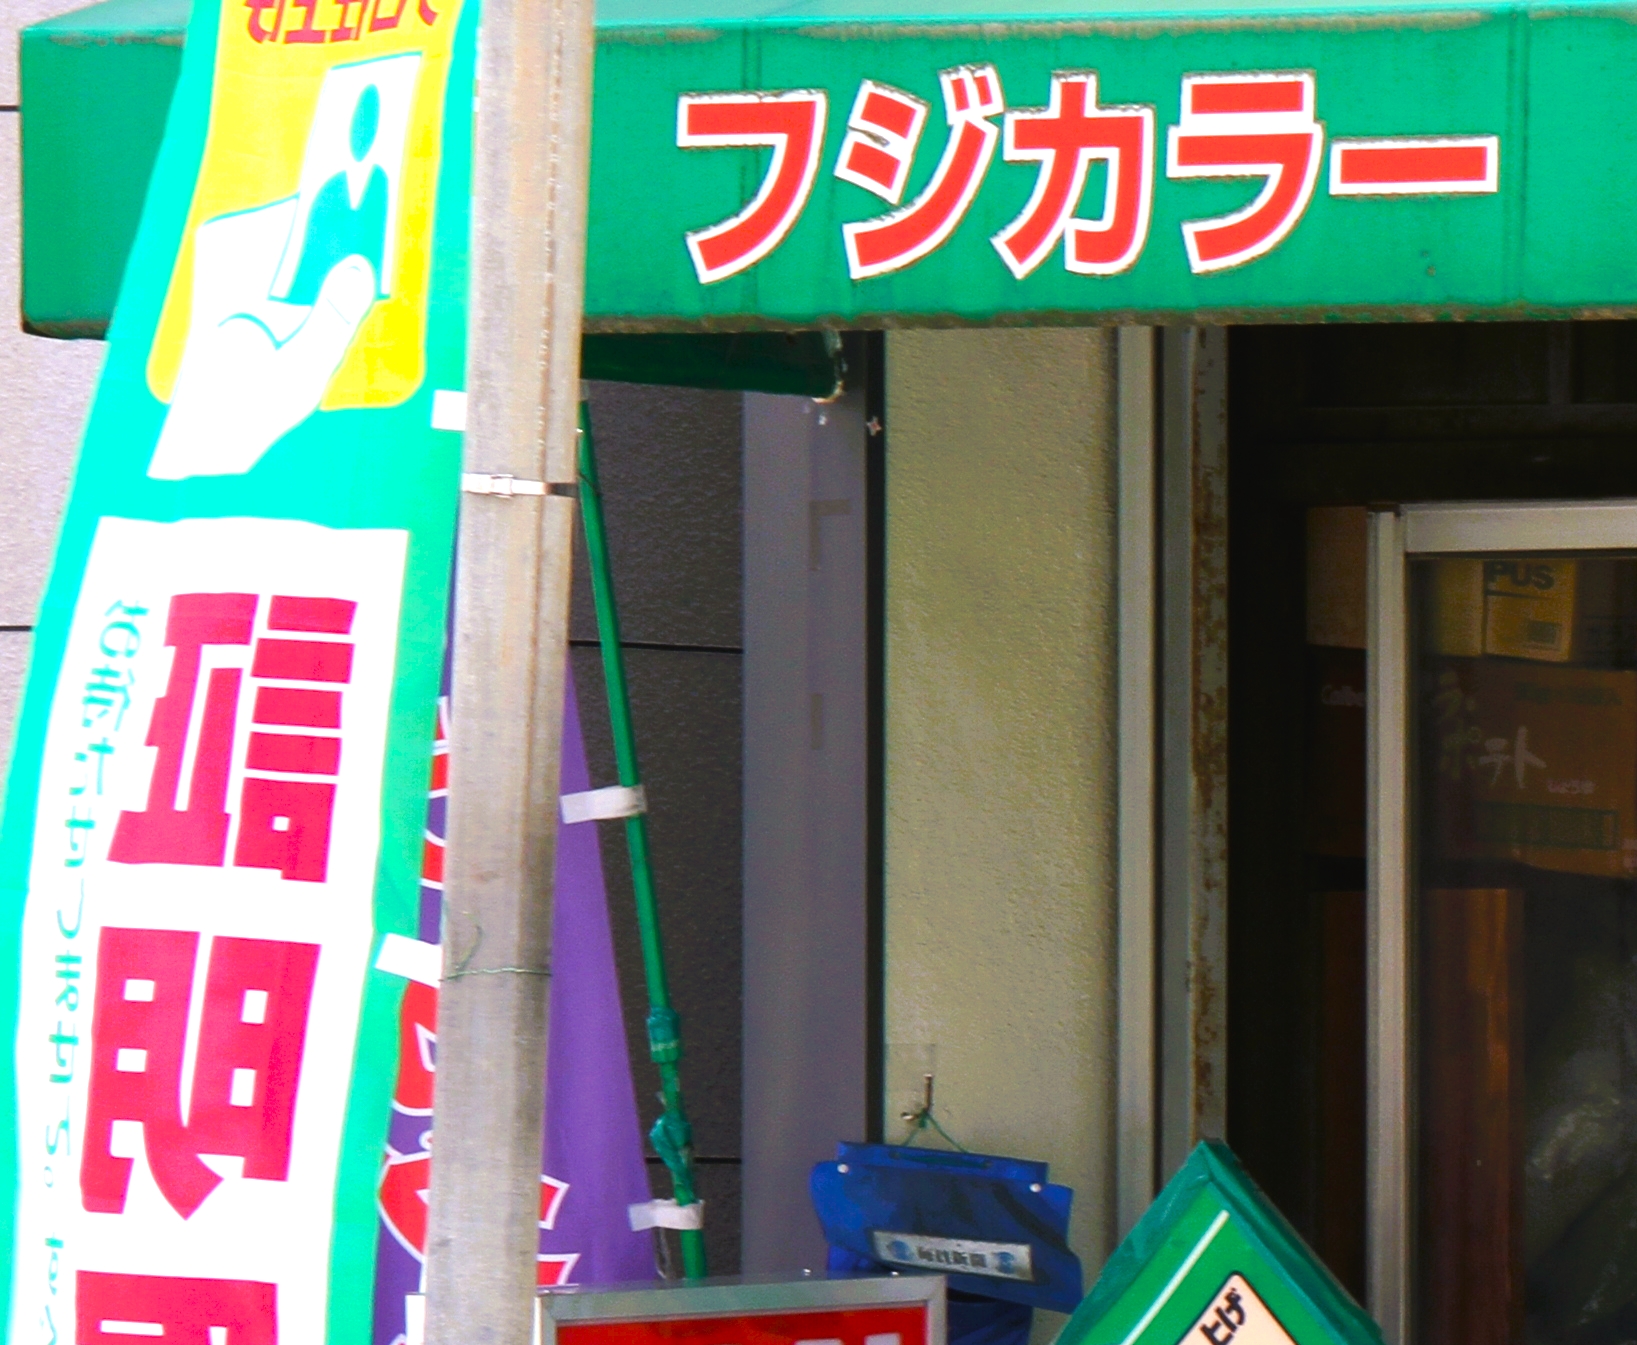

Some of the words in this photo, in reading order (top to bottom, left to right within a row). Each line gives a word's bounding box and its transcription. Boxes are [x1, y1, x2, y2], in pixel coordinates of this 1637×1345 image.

[677, 63, 1500, 284] フジカラー
